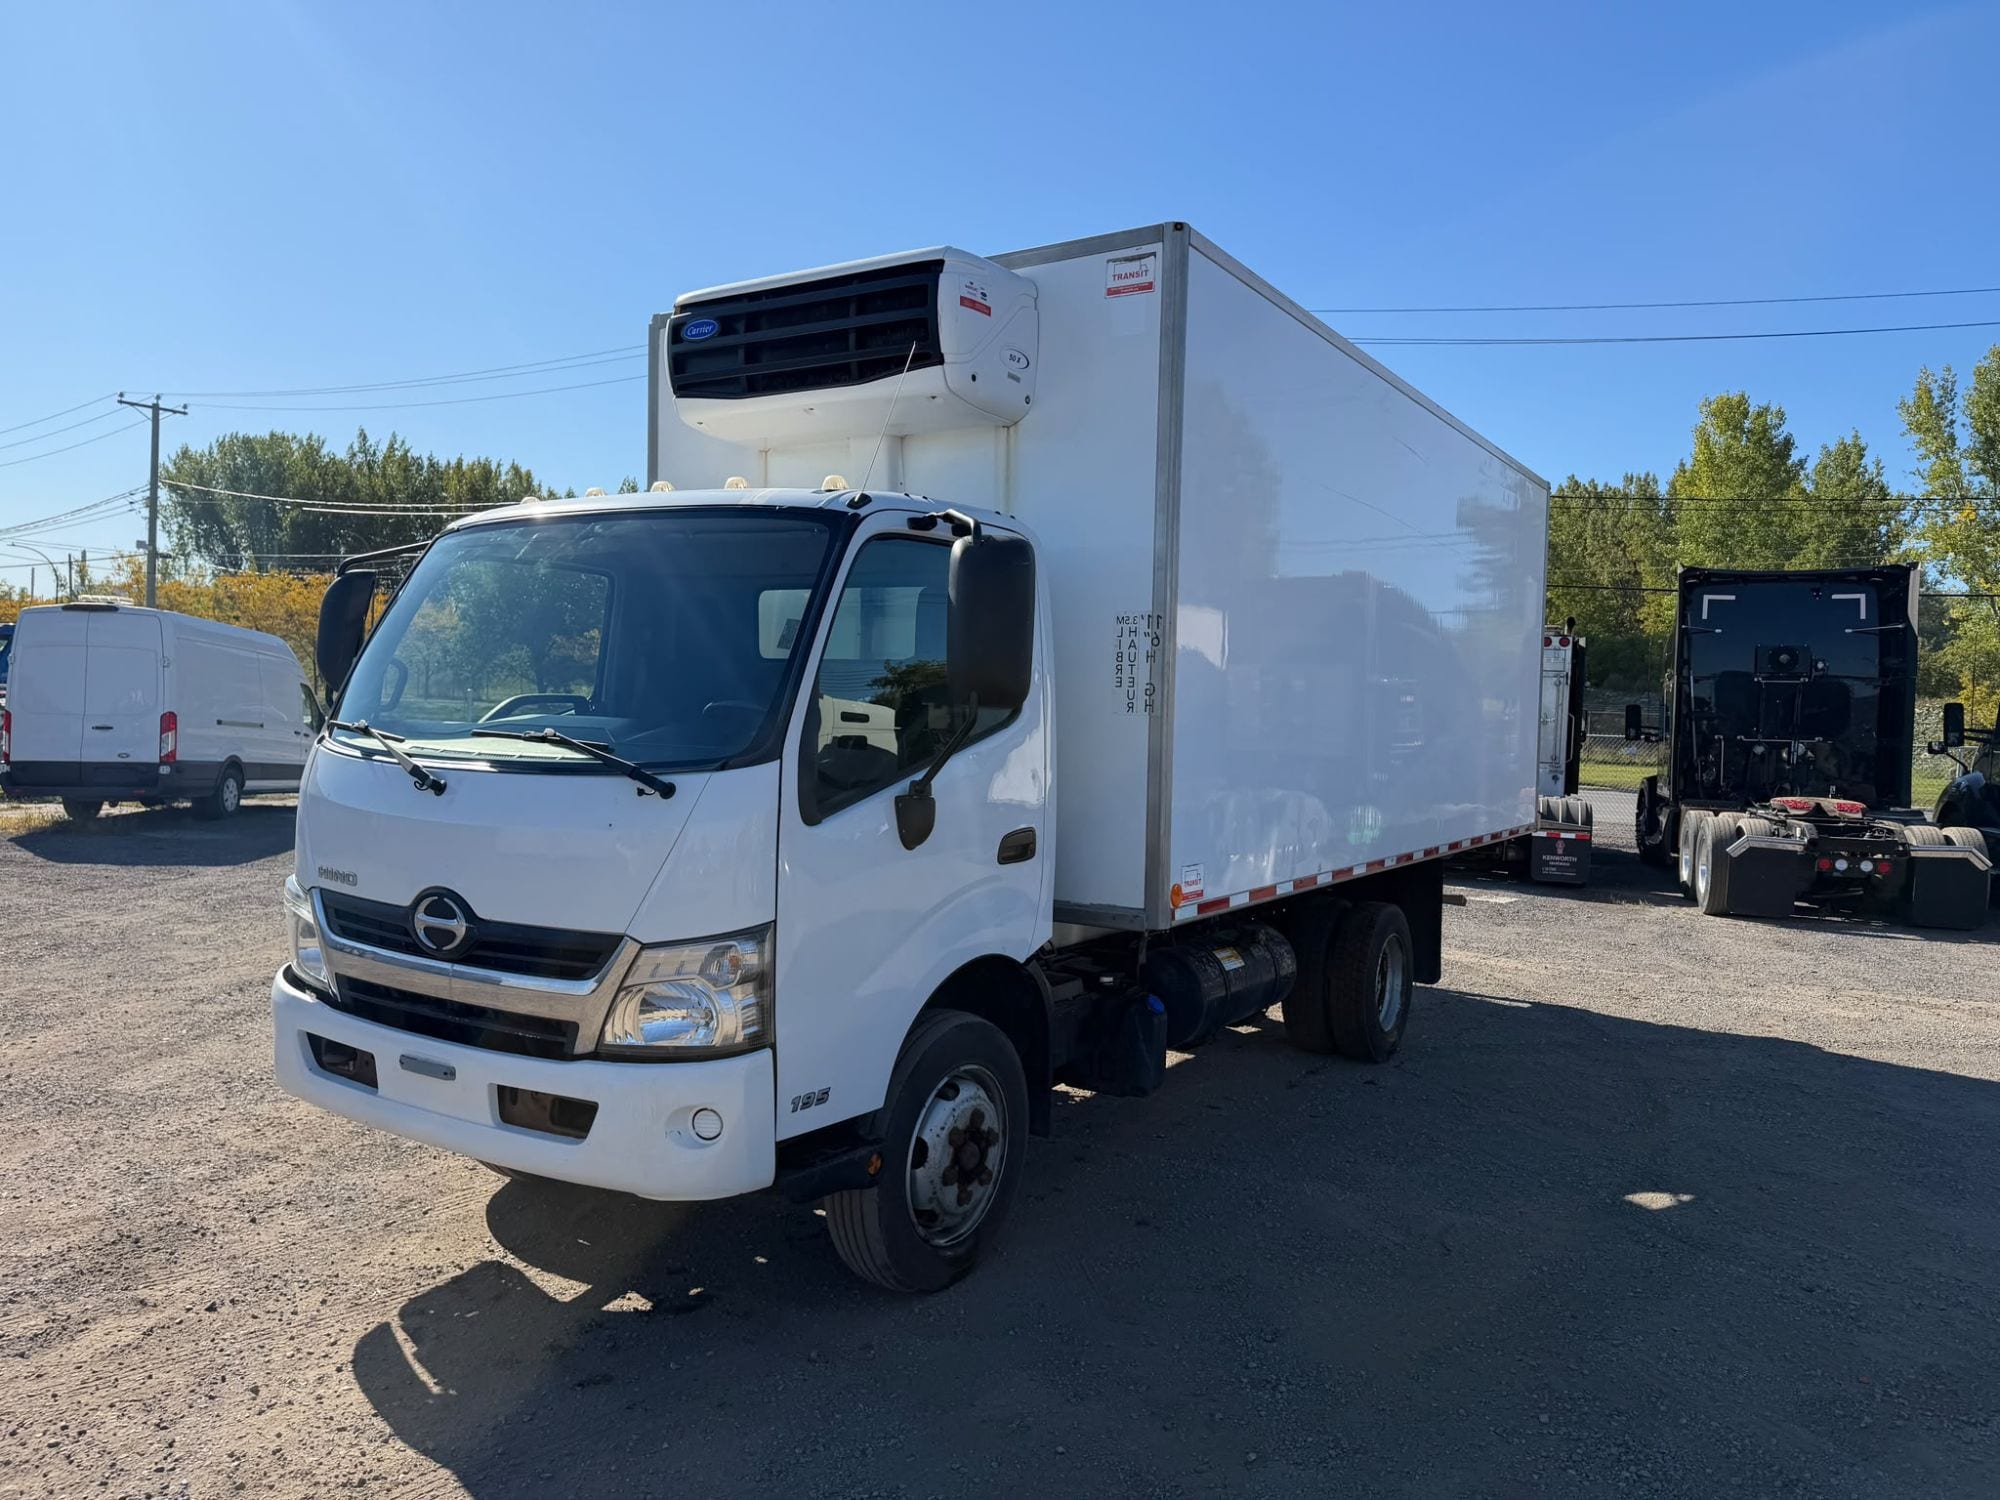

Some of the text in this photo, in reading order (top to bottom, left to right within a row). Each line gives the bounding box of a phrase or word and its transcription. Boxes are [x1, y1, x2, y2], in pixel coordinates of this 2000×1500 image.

[1112, 269, 1150, 281] TRANSIT
[687, 323, 714, 336] Carrier
[1008, 353, 1017, 362] 50
[1542, 854, 1577, 862] KENWORTH
[318, 866, 358, 887] HINO
[790, 1086, 832, 1113] 195
